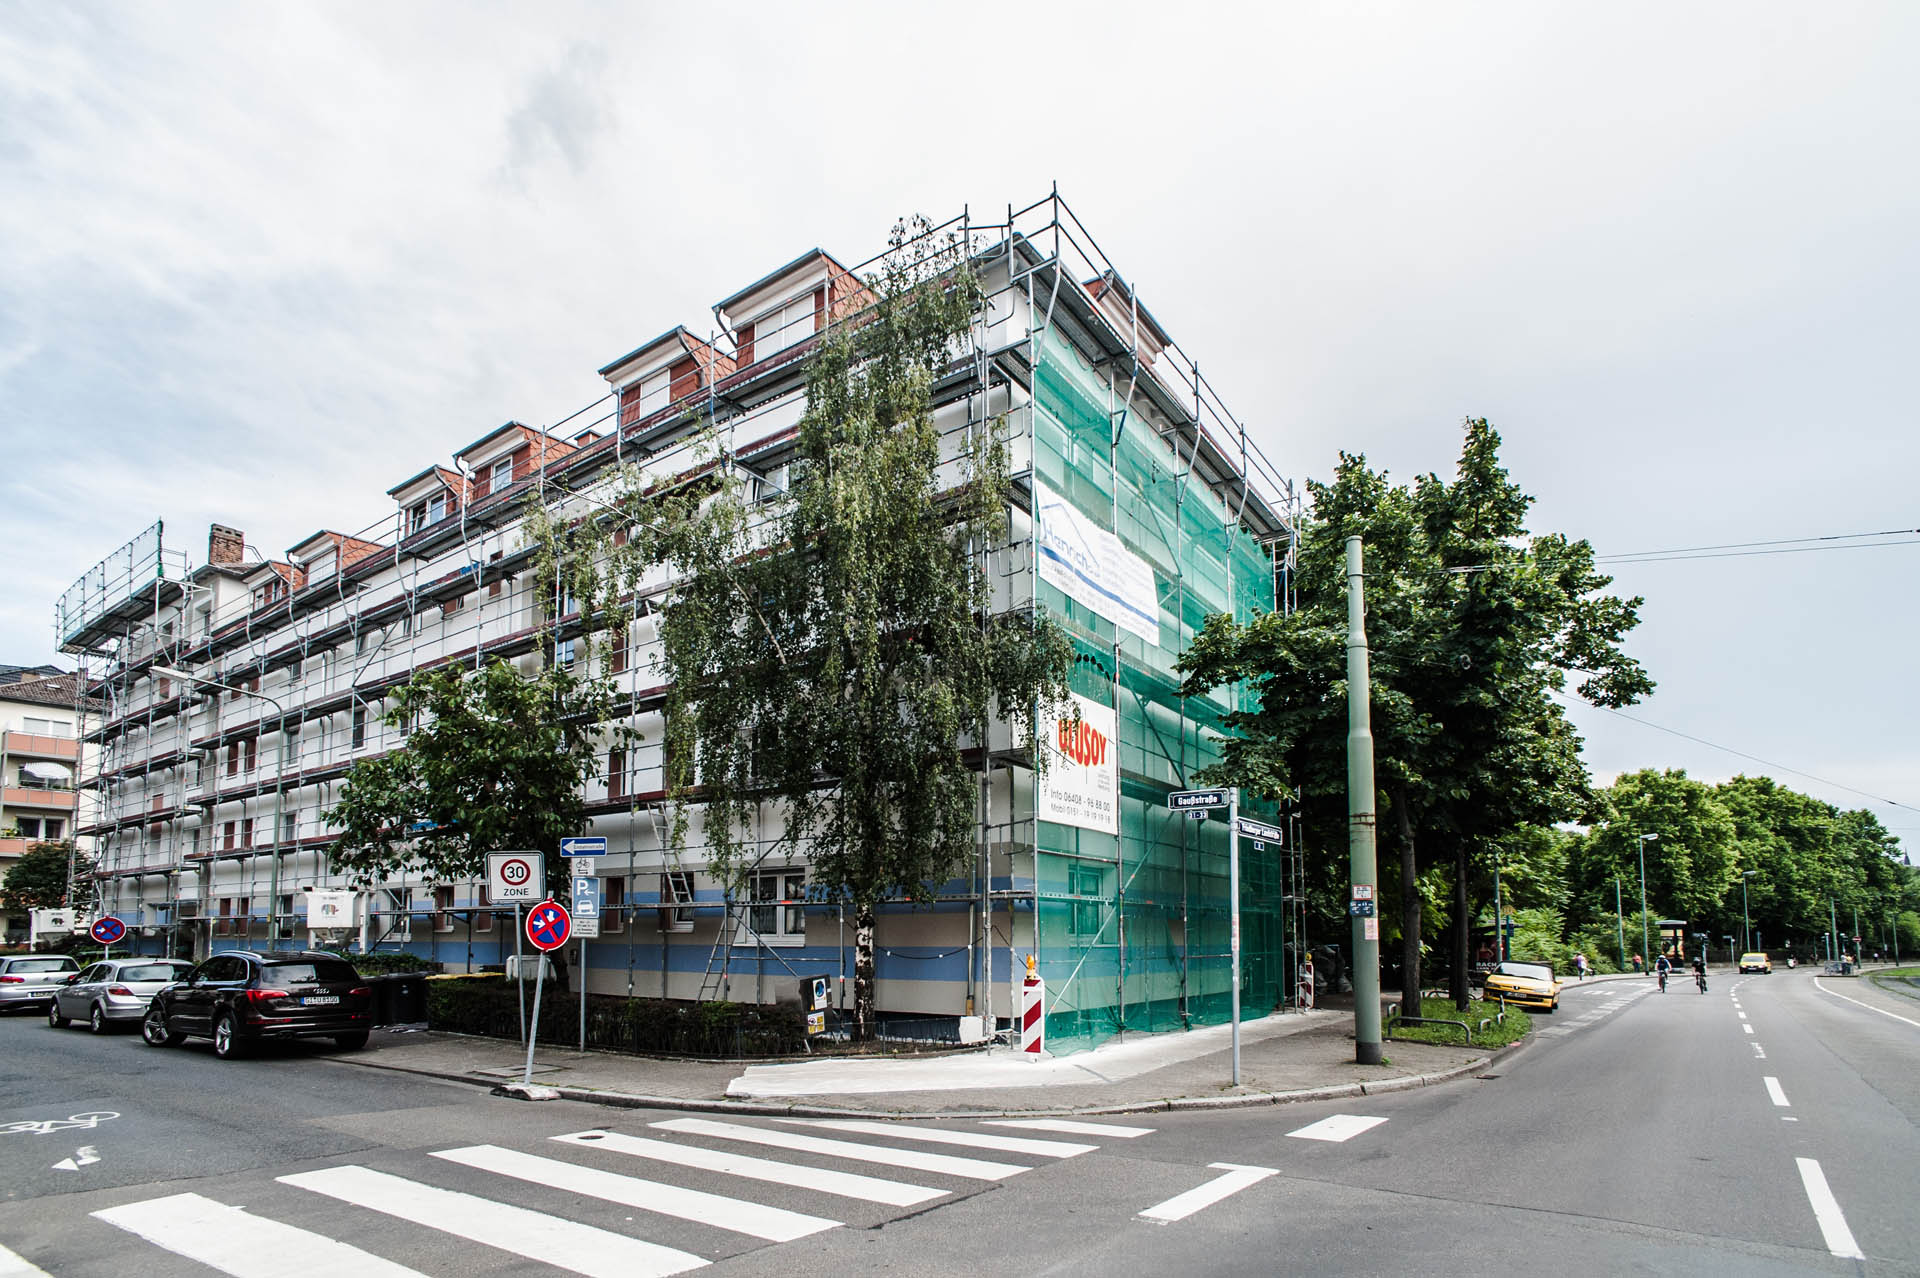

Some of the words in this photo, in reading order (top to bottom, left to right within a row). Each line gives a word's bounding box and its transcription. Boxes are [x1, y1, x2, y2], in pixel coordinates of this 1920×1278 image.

[1058, 719, 1107, 767] ULUSOY
[1050, 789, 1063, 800] Info
[1178, 795, 1218, 805] Gaußstraße
[1050, 803, 1066, 814] Mobil
[506, 866, 524, 879] 30
[504, 887, 529, 897] ZONE
[577, 880, 589, 896] P
